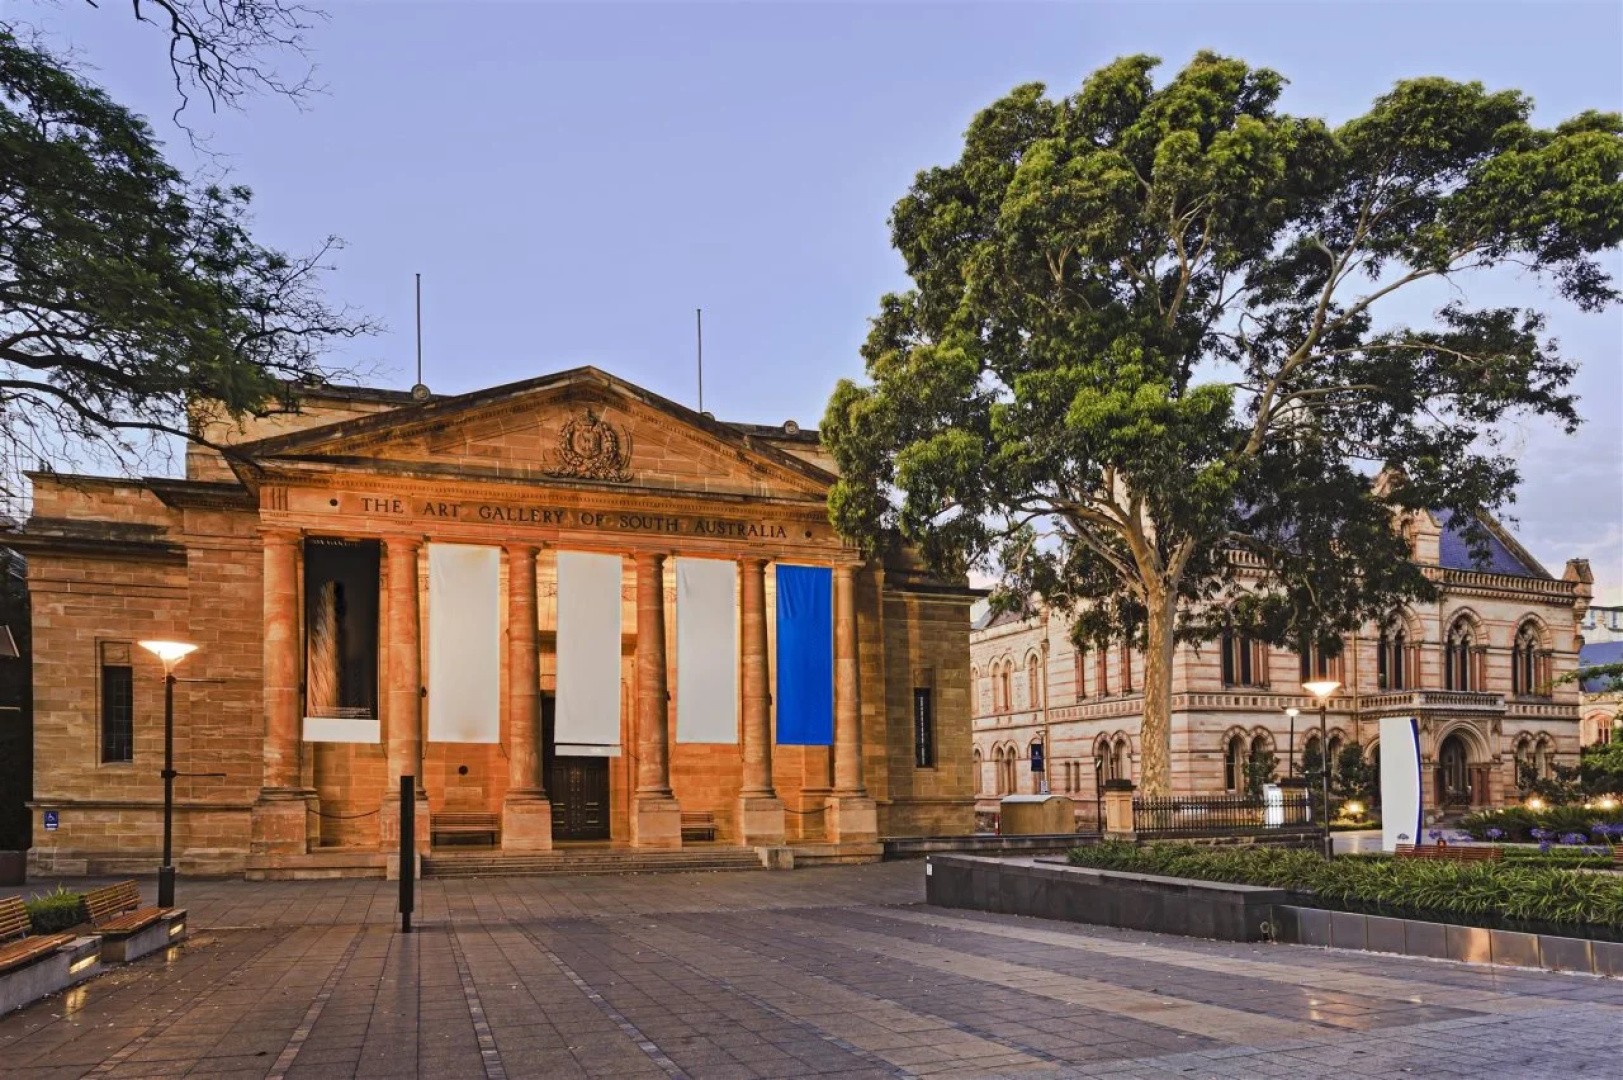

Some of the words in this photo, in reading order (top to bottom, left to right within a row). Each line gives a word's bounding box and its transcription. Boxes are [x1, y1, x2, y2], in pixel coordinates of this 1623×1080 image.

[361, 497, 404, 514] THE
[422, 501, 461, 518] ART
[478, 506, 565, 524] GALLERY
[580, 512, 602, 527] OF
[619, 515, 679, 532] SOUTH
[694, 521, 788, 538] AUSTRALIA
